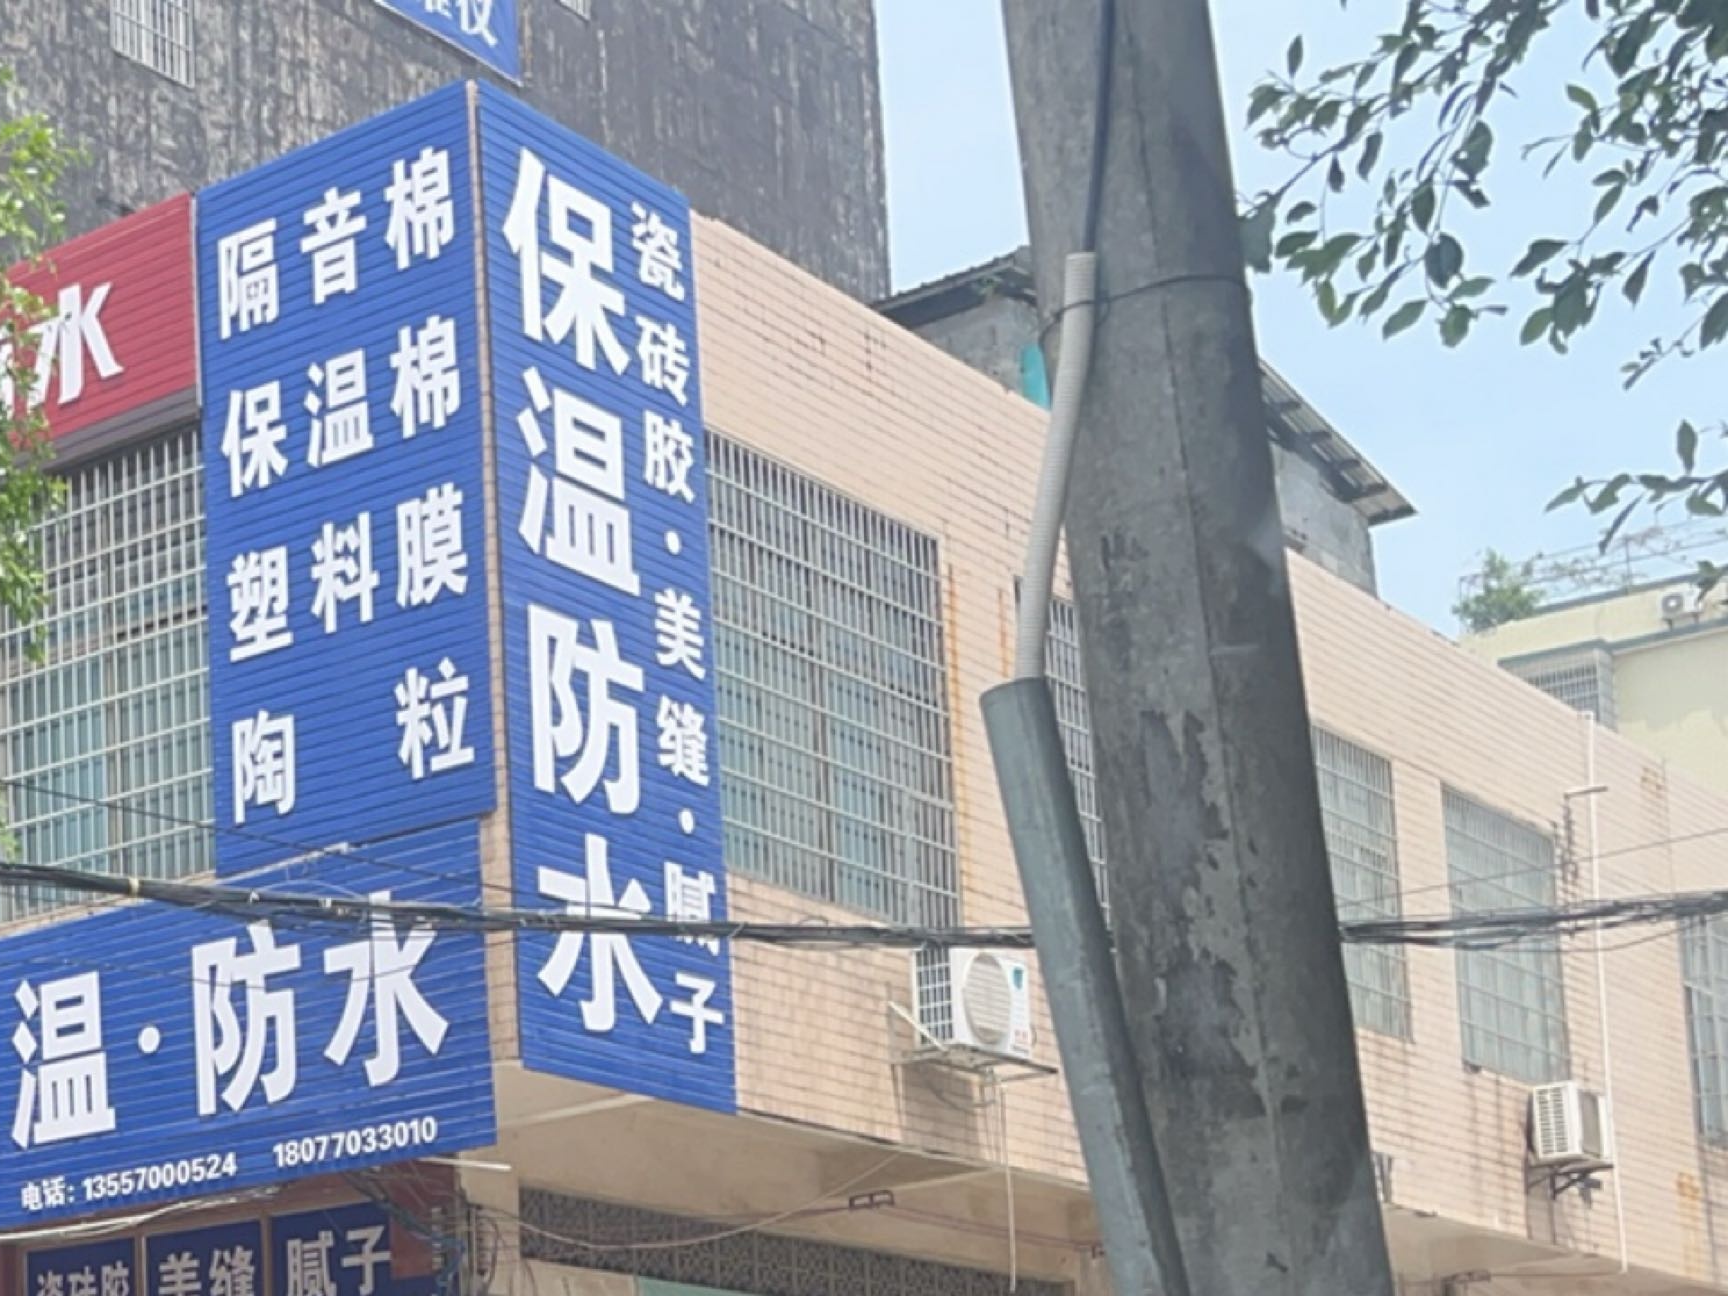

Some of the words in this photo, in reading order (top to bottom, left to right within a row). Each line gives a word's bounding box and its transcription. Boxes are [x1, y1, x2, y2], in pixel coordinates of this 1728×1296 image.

[218, 147, 456, 340] 隔音棉
[222, 315, 461, 497] 保温棉
[227, 483, 468, 663] 塑料膜
[503, 147, 663, 1031] 保温防水
[233, 657, 475, 824] 陶粒
[273, 1115, 438, 1168] 18077033010
